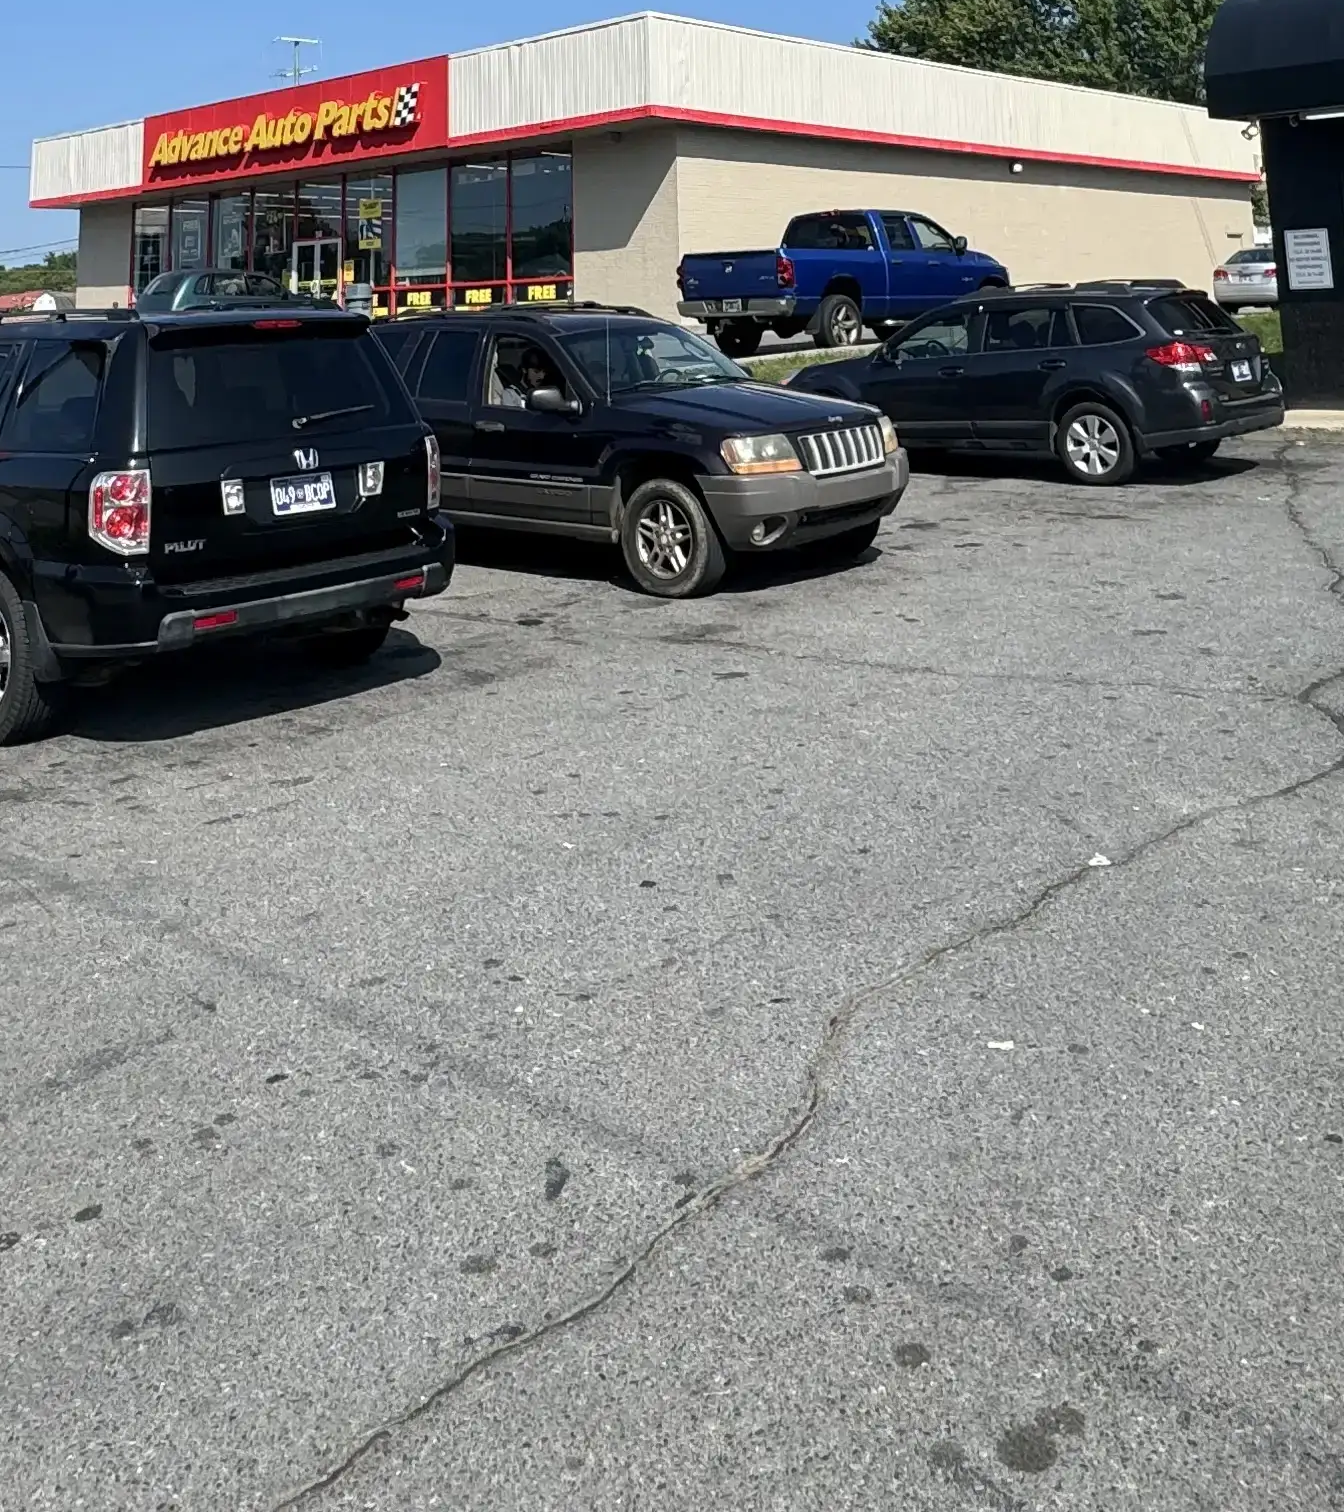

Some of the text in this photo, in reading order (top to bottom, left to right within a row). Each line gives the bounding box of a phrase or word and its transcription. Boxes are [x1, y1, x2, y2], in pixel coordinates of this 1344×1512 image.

[148, 92, 392, 168] Advance Auto Parts
[407, 291, 432, 306] FREE
[465, 288, 492, 304] FREE
[527, 284, 557, 301] FREE
[164, 538, 207, 555] PILOT
